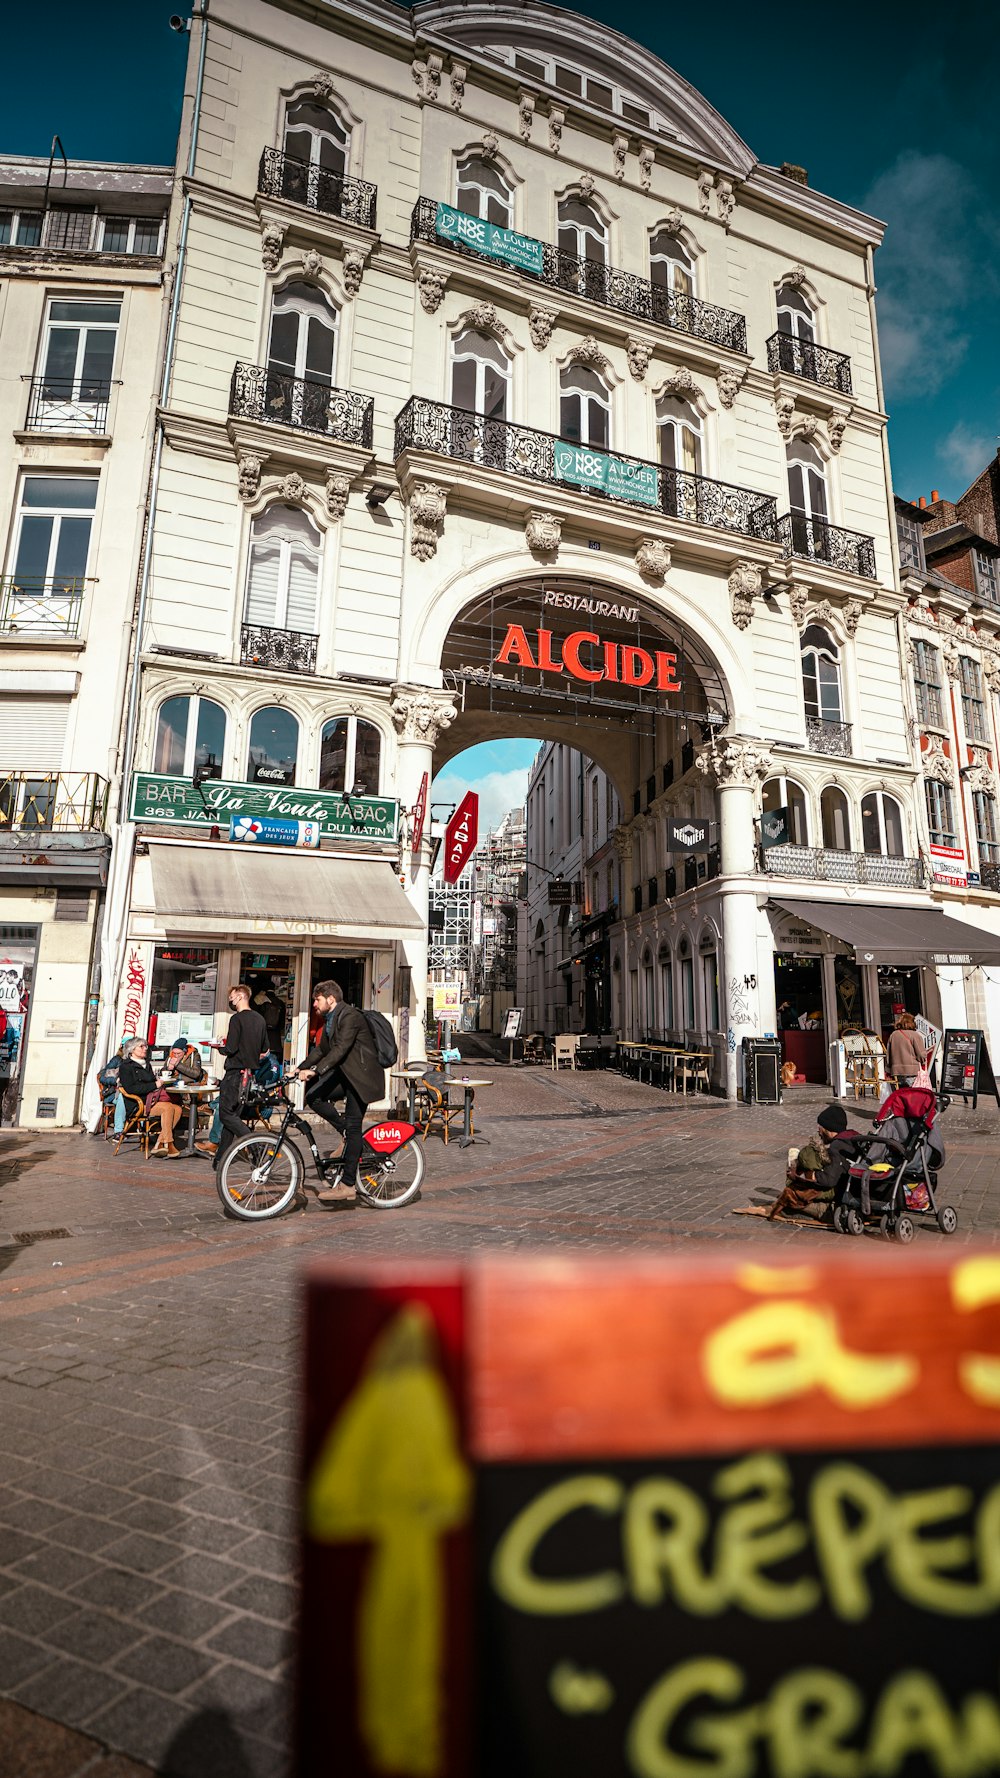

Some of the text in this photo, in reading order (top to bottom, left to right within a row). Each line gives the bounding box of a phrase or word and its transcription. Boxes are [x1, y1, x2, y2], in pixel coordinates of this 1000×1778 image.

[458, 216, 485, 232] NOC
[457, 225, 485, 243] NOC
[504, 233, 539, 255] LOUER
[576, 451, 602, 468] NOC
[575, 463, 602, 479] NOC
[621, 466, 654, 485] LOUER
[544, 590, 640, 623] RESTAURANT
[495, 623, 681, 692] ALCIDE
[146, 784, 186, 804] BAR
[205, 787, 245, 810] La
[264, 791, 328, 821] Voute
[333, 802, 387, 822] TABAC
[144, 806, 220, 822] 365 J/AN
[304, 822, 314, 848] LOTO
[328, 822, 345, 833] DU
[350, 825, 386, 837] MATIN
[450, 812, 472, 864] TABAC
[673, 826, 705, 847] MEUNIER
[254, 920, 338, 934] LA VOUTE
[744, 974, 757, 989] 45
